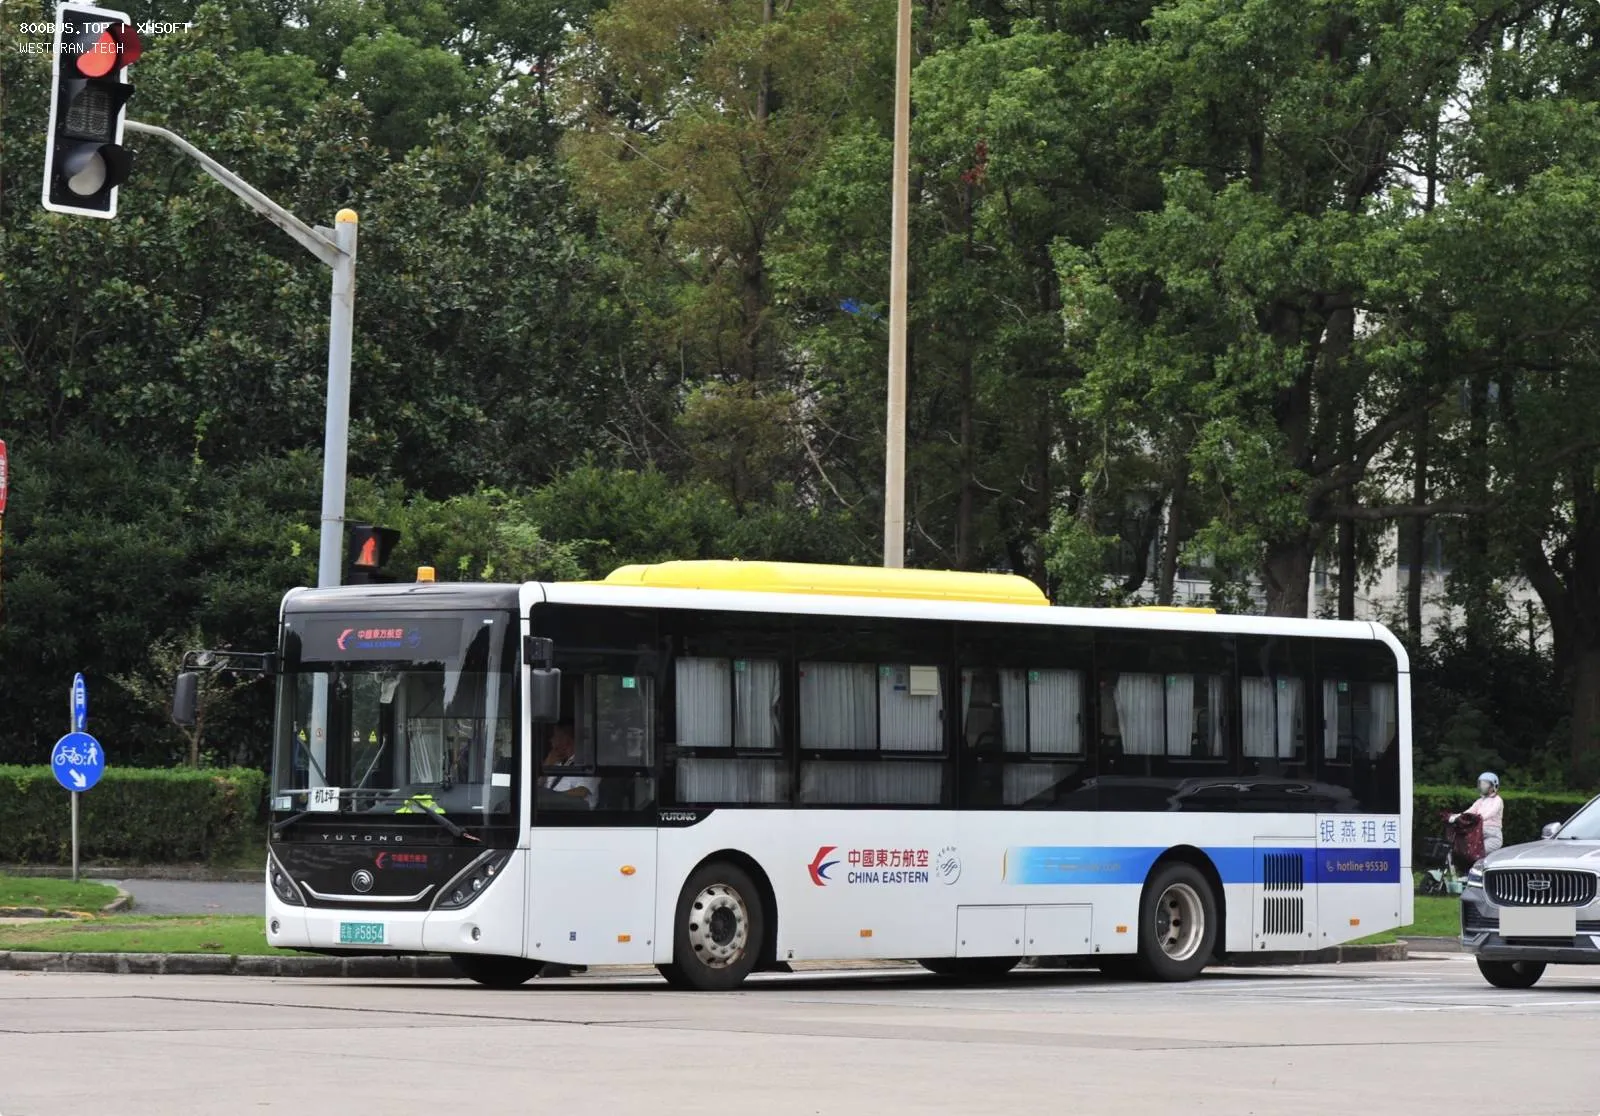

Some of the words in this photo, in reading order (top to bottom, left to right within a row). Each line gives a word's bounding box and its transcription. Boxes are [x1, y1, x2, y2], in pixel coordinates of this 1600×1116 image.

[315, 789, 336, 804] 机坪
[660, 812, 697, 821] YUTONG
[1320, 819, 1397, 843] 银燕租赁
[322, 834, 403, 842] YUTONG
[848, 849, 929, 868] 中國東方航空
[1337, 860, 1364, 871] hotline
[1366, 861, 1388, 872] 95530
[848, 871, 879, 884] CHINA
[882, 871, 929, 884] EASTERN
